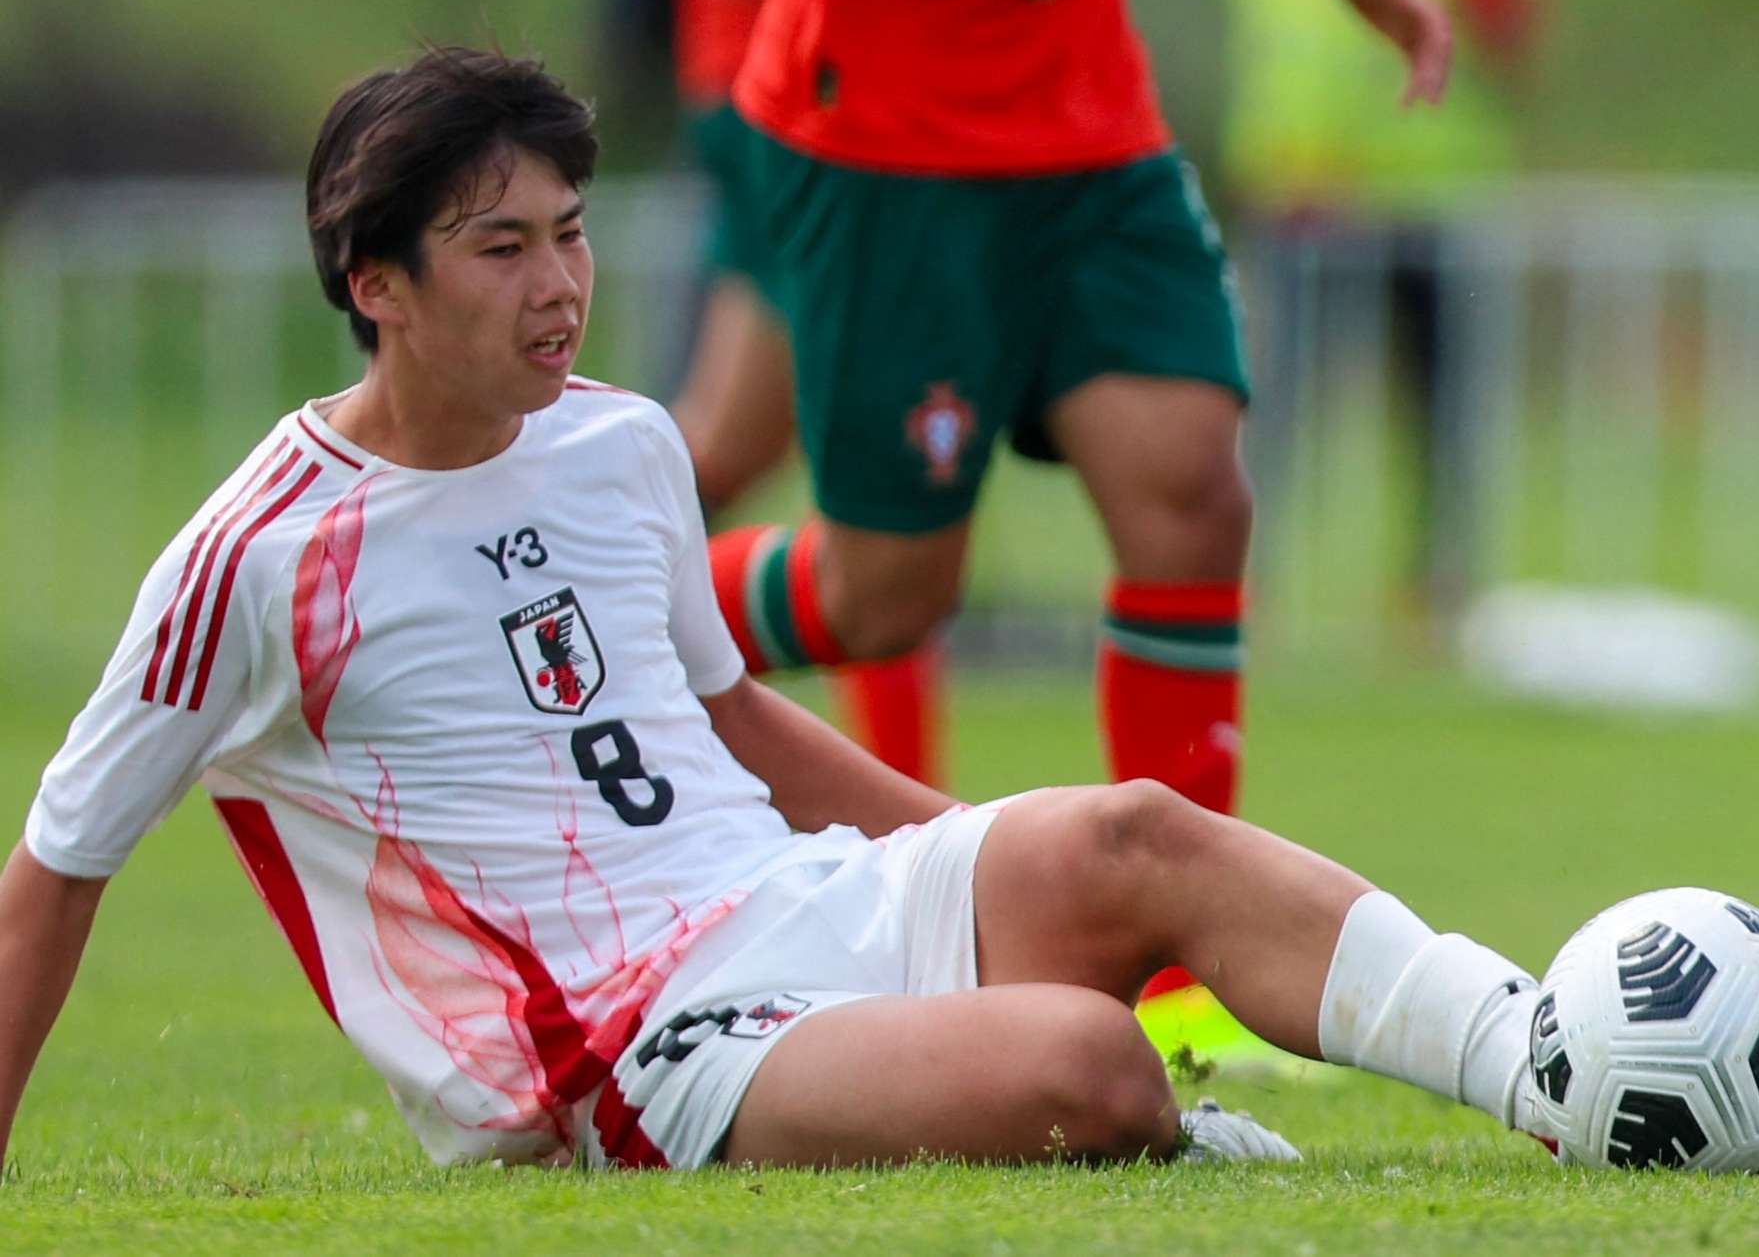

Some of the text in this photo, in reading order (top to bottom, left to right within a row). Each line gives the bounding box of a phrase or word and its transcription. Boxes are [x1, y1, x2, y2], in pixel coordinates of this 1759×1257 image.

[474, 526, 549, 581] Y-3
[519, 595, 560, 623] JAPAN
[570, 719, 675, 828] 8
